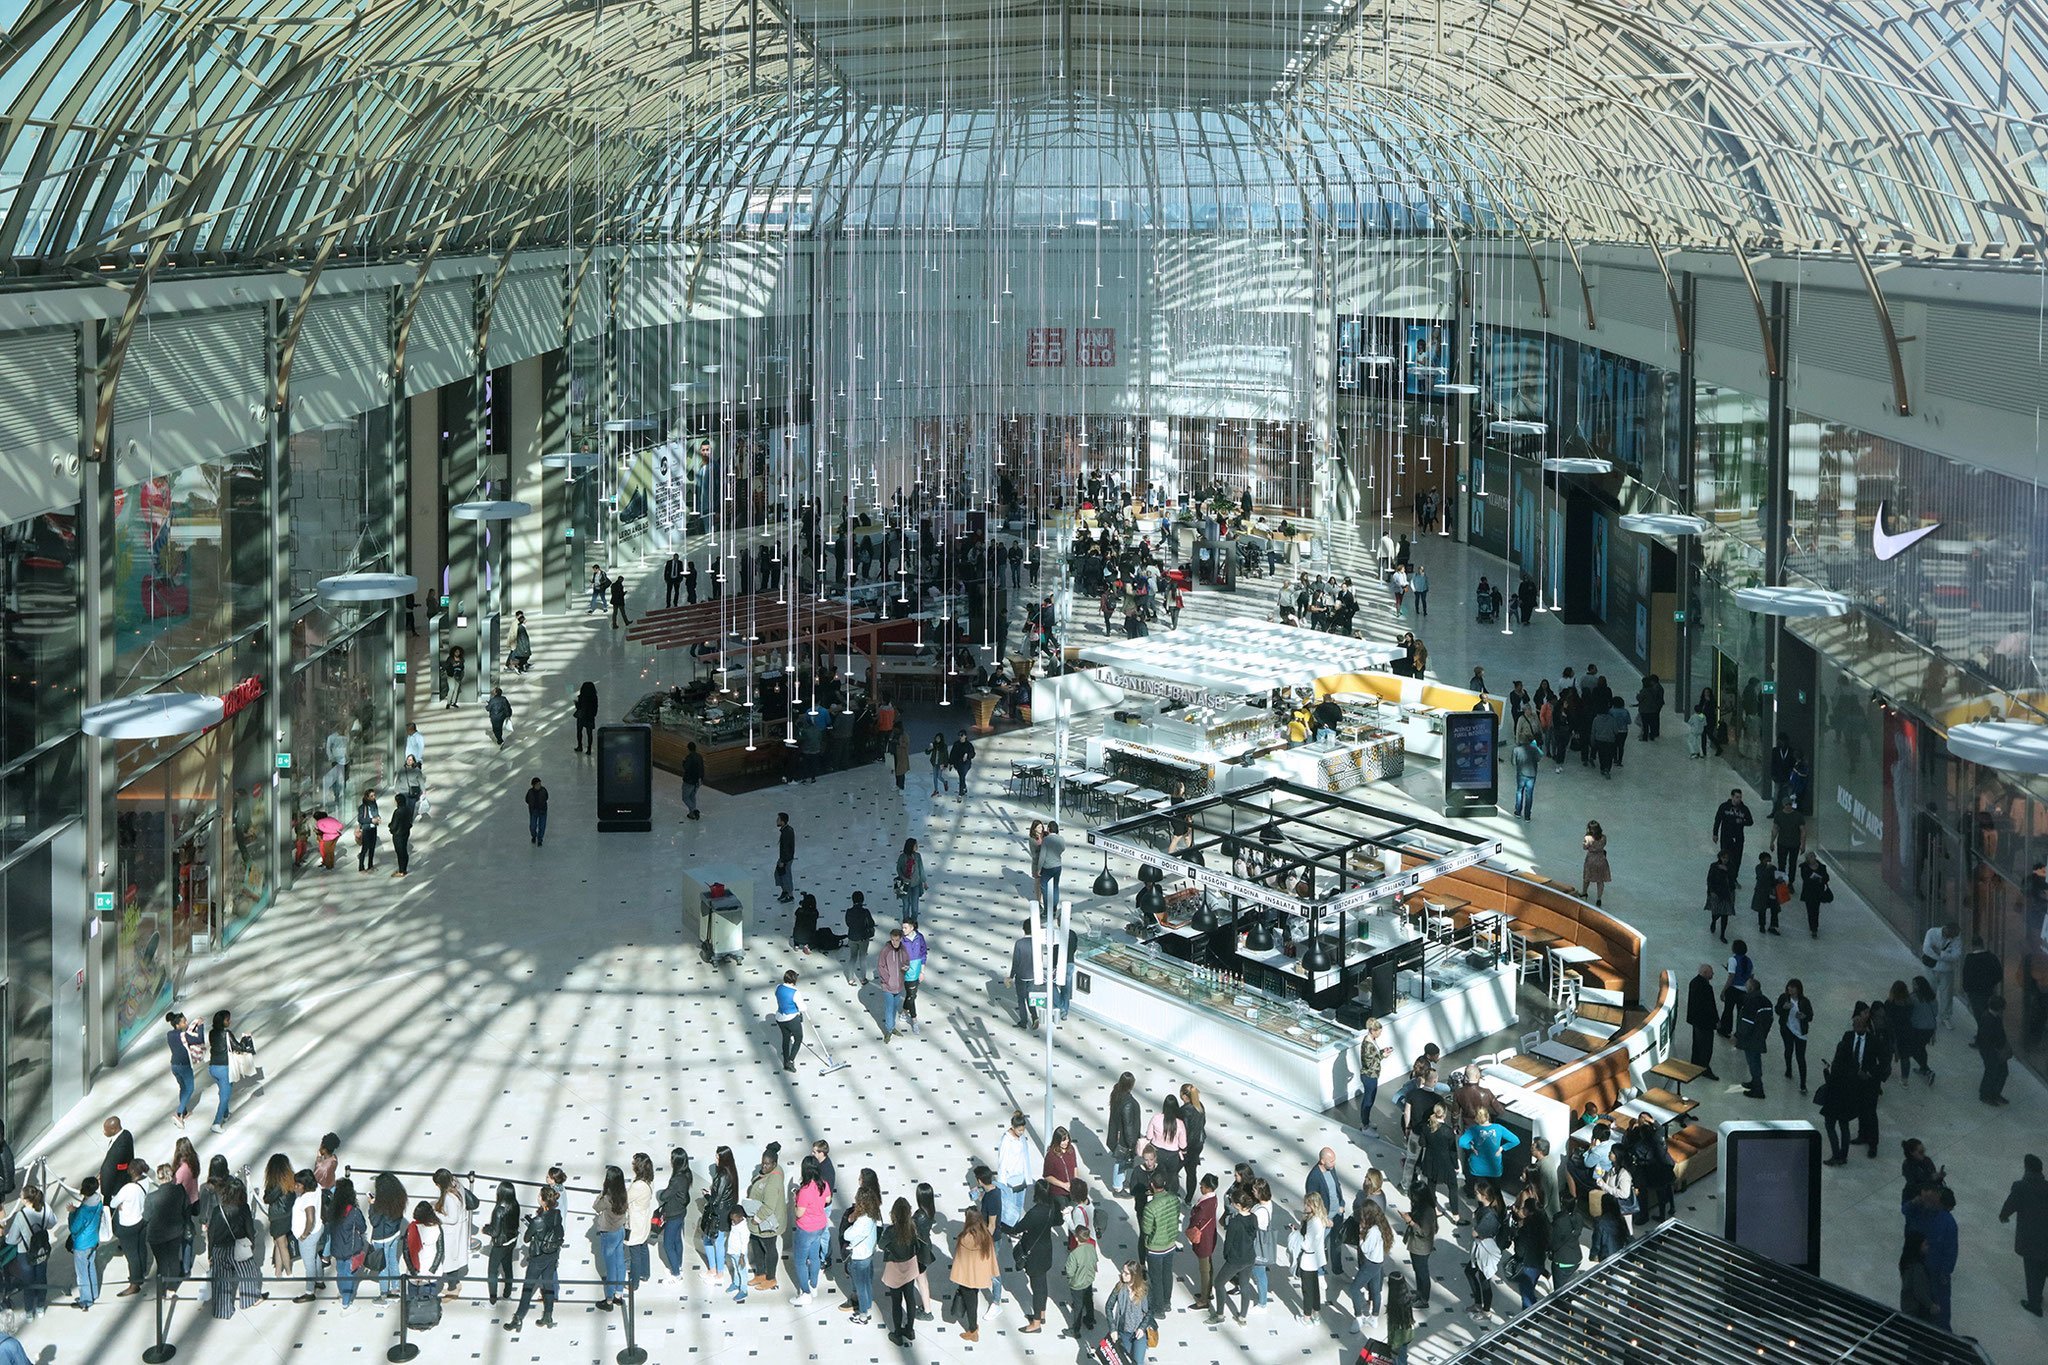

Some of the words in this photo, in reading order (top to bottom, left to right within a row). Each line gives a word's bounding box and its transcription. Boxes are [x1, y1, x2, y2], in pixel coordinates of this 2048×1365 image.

[1081, 333, 1109, 347] UNI
[1081, 349, 1112, 365] QLO
[1837, 785, 1852, 812] KISS
[1853, 799, 1866, 825] MY
[1866, 810, 1884, 841] AIRS
[1103, 840, 1120, 851] FRESH
[1120, 848, 1135, 857] JUICE
[1161, 861, 1179, 872] DOLCE
[1201, 874, 1228, 888] LASAGNE
[1233, 885, 1259, 899] PIADINA
[1264, 896, 1296, 911] INSALATA
[1333, 895, 1364, 910] RISTORANTE
[1368, 889, 1379, 898] BAR
[1382, 881, 1406, 893] ITALIANO
[1435, 863, 1454, 874] FRESCO
[1456, 853, 1481, 866] EVERYDAY
